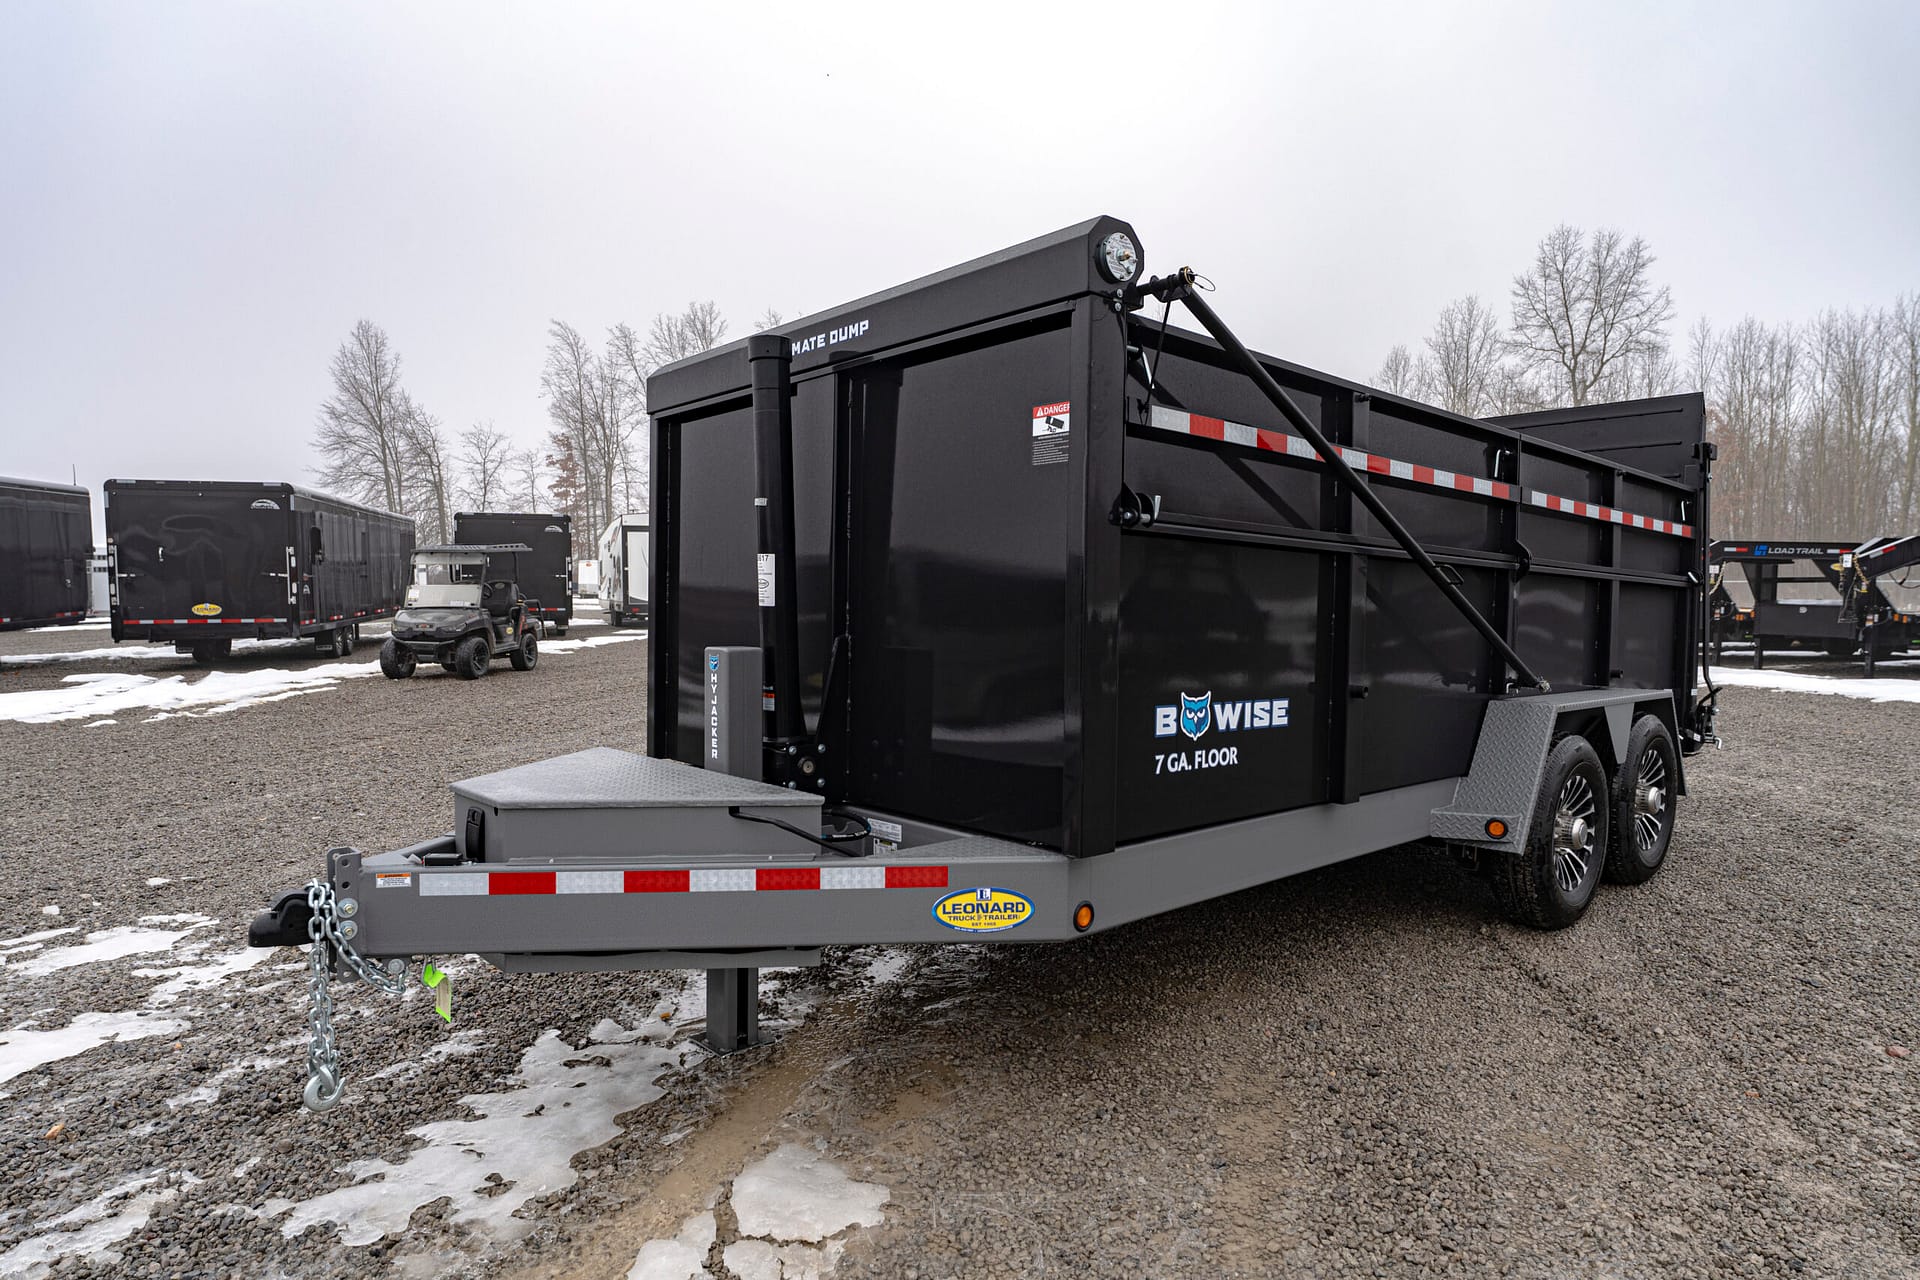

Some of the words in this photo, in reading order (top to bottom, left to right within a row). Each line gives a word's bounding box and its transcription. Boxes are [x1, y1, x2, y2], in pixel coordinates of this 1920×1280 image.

[792, 333, 826, 356] MATE
[829, 320, 869, 345] DUMP
[1155, 754, 1165, 775] 7
[1167, 752, 1192, 773] GA.
[1194, 746, 1238, 769] FLOOR
[942, 902, 1025, 915] LEONARD
